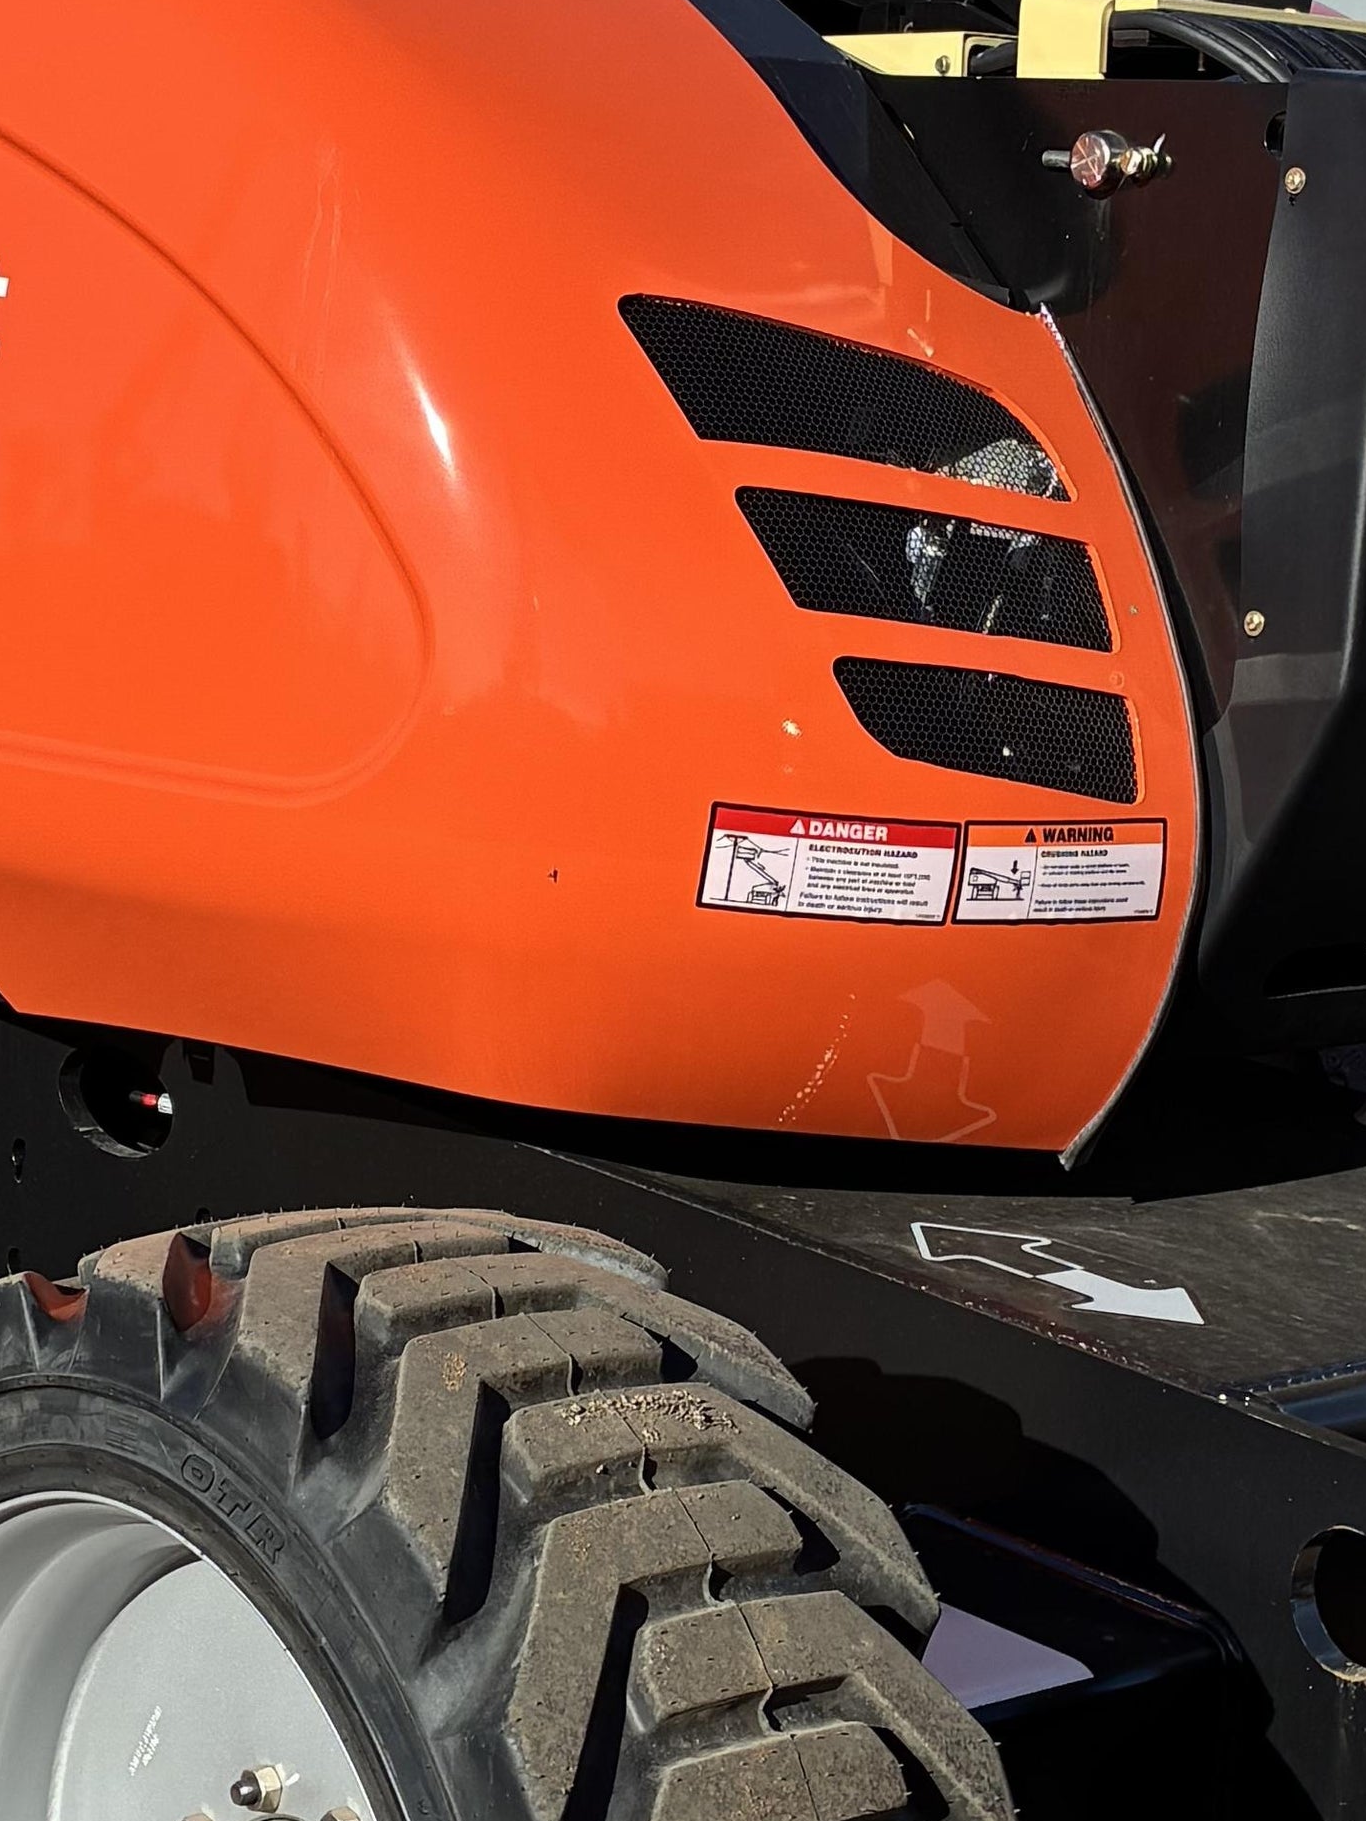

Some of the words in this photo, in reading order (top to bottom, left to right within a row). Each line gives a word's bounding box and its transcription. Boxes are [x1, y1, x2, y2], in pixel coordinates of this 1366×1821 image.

[809, 820, 889, 842] DANGER
[1042, 827, 1115, 843] WARNING
[808, 844, 882, 856] ELECTROCUTION
[884, 851, 918, 859] HAZARD
[179, 1452, 286, 1566] OTR
